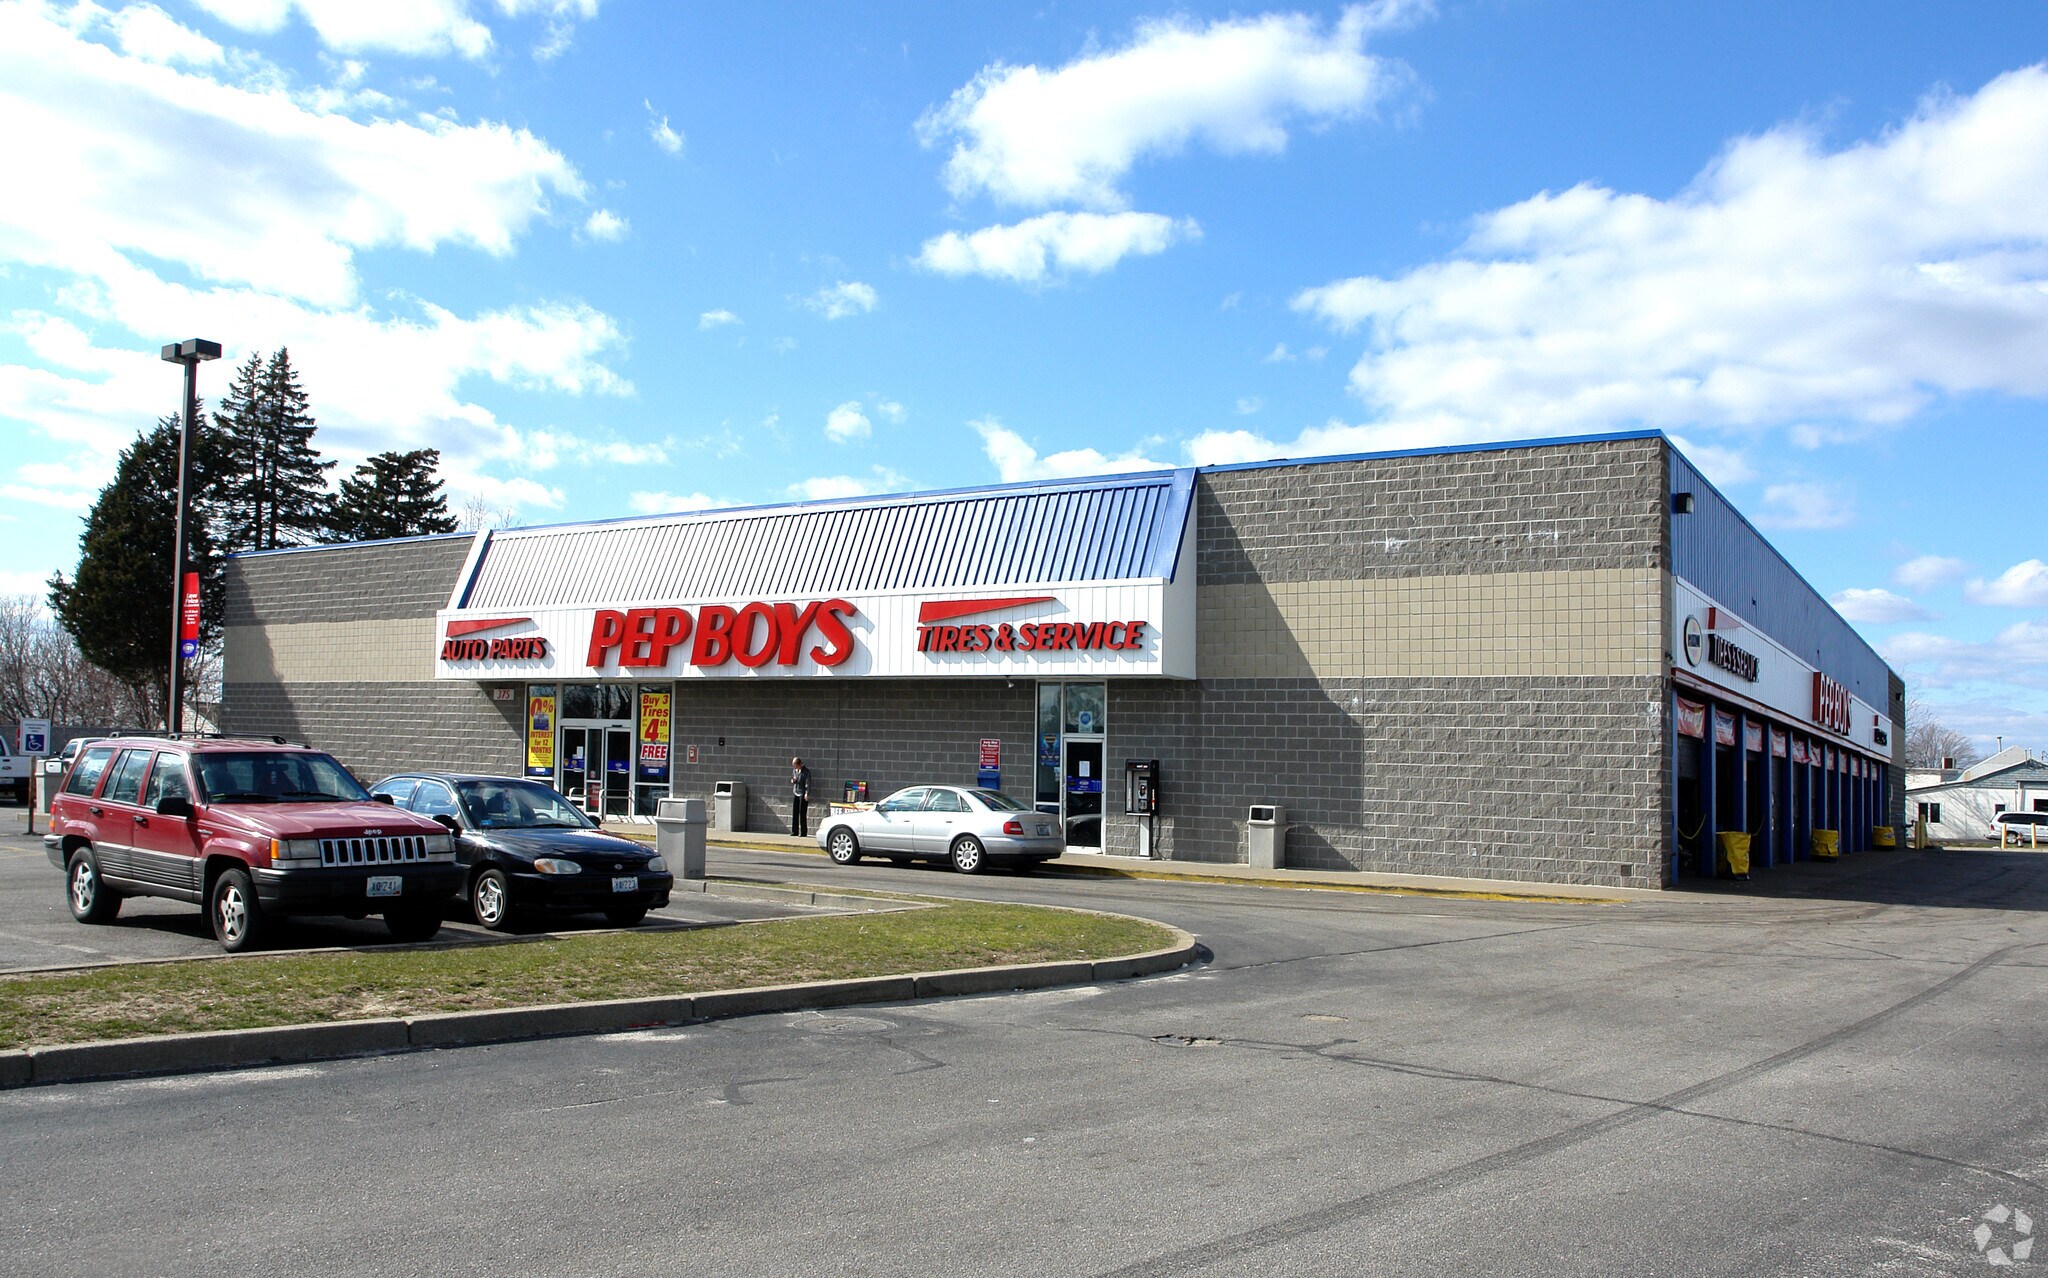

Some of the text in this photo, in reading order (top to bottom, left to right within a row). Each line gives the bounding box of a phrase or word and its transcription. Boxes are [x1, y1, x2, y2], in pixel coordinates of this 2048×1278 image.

[586, 598, 858, 668] PEP BOYS
[916, 621, 1147, 652] TIRES & SERVICE
[440, 637, 547, 661] AUTO PARTS
[497, 690, 511, 699] 375
[643, 695, 669, 706] Buy 3
[643, 705, 669, 717] Tires
[530, 746, 552, 754] MONTHS
[641, 745, 668, 759] FREE
